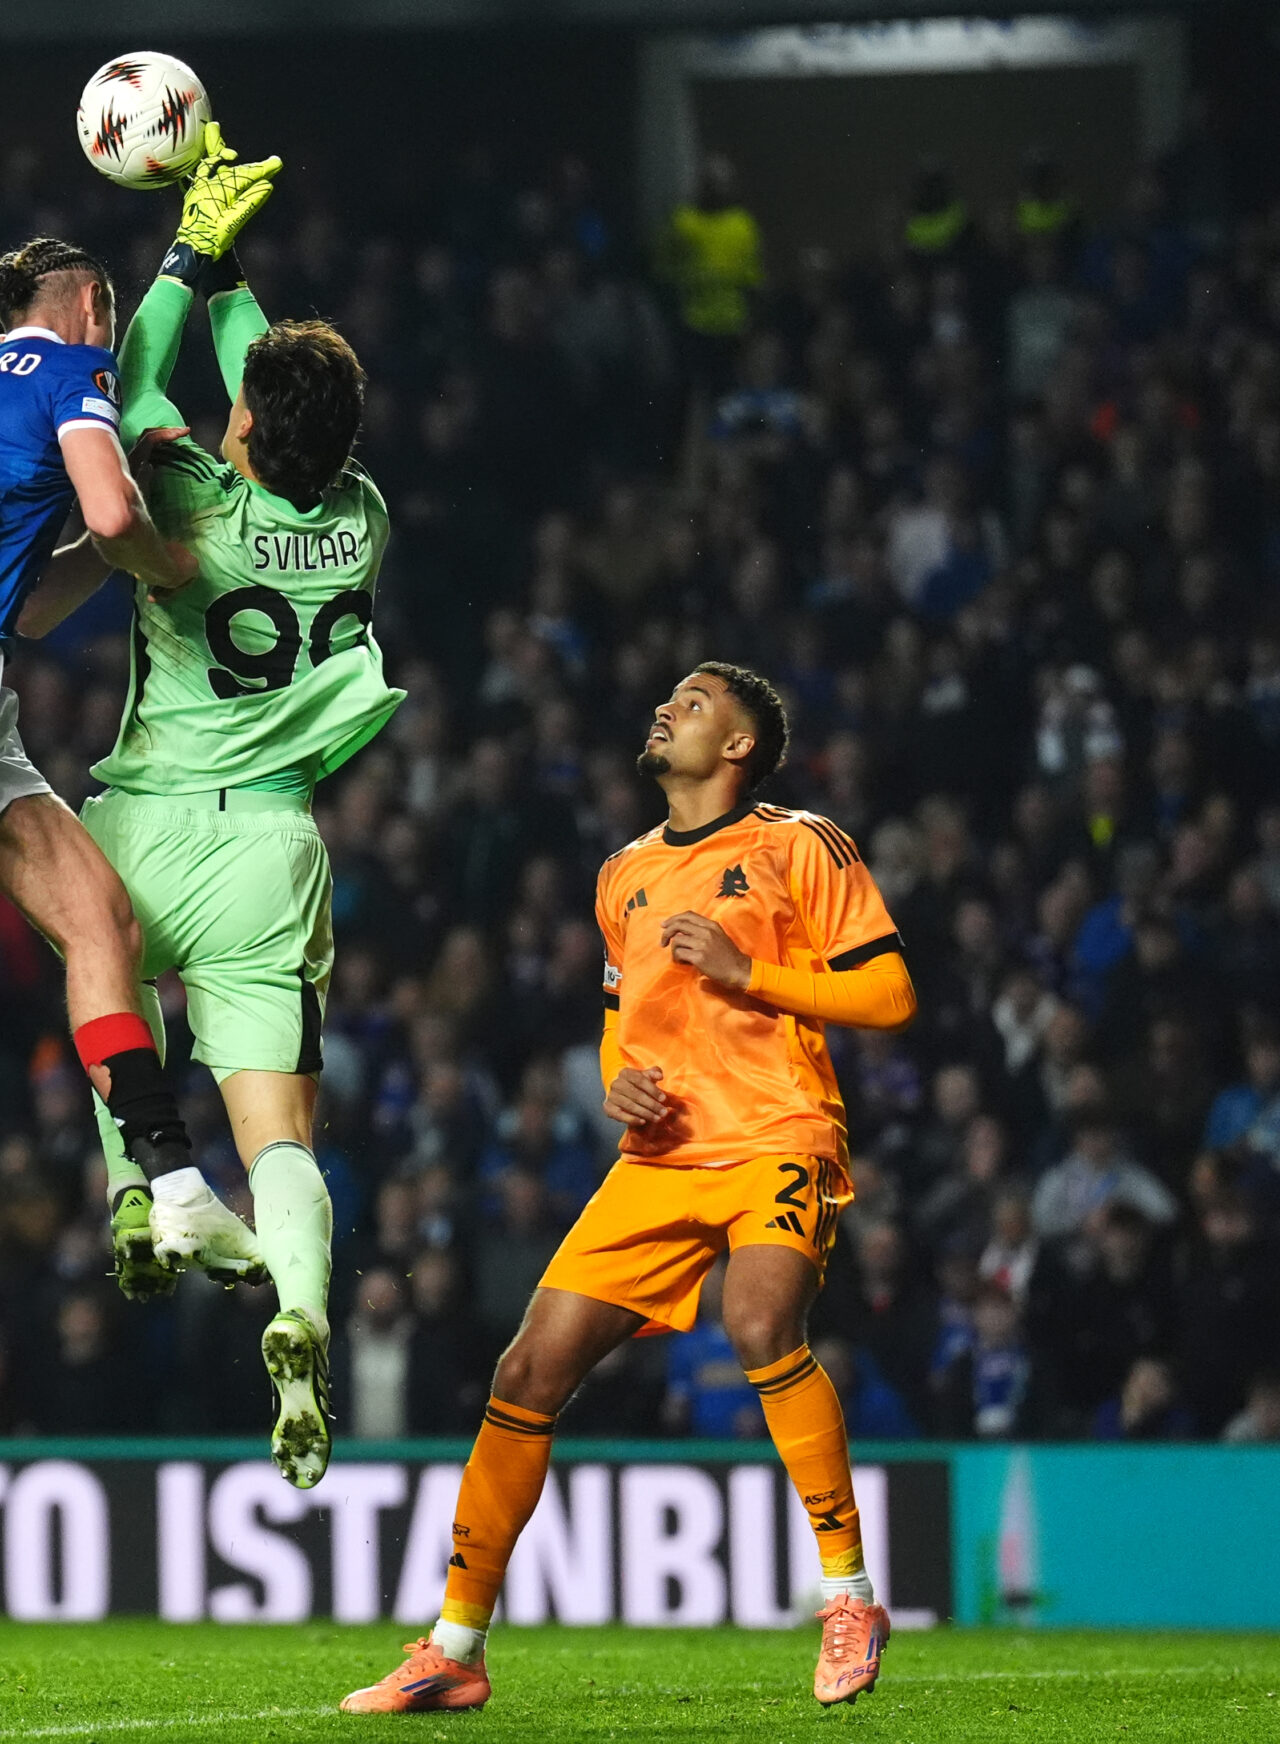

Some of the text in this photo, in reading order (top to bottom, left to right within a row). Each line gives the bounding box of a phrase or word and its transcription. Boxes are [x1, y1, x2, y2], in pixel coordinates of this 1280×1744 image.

[225, 202, 257, 234] uhlsport
[254, 531, 359, 571] SVILAR
[774, 1162, 809, 1212] 2
[804, 1490, 836, 1506] ASR
[156, 1461, 937, 1627] ISTANBUL
[452, 1522, 470, 1539] SR
